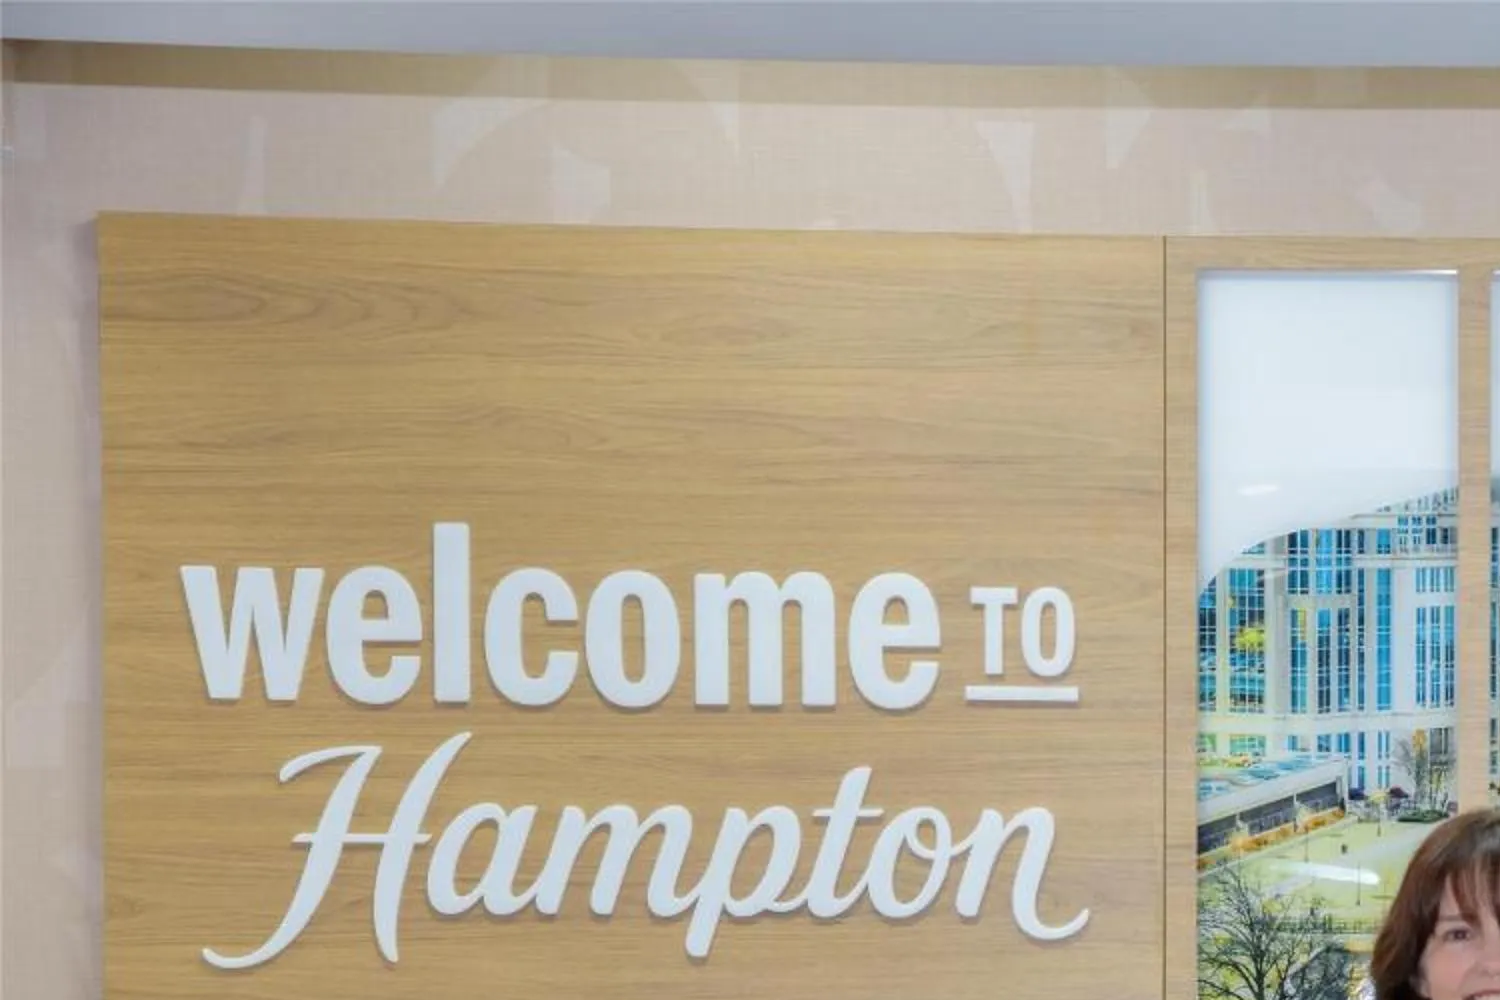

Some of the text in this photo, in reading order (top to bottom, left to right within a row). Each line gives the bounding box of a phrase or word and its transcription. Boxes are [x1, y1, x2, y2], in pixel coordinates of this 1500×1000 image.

[180, 522, 1077, 709] welcome TO
[202, 731, 1090, 970] Hampton
